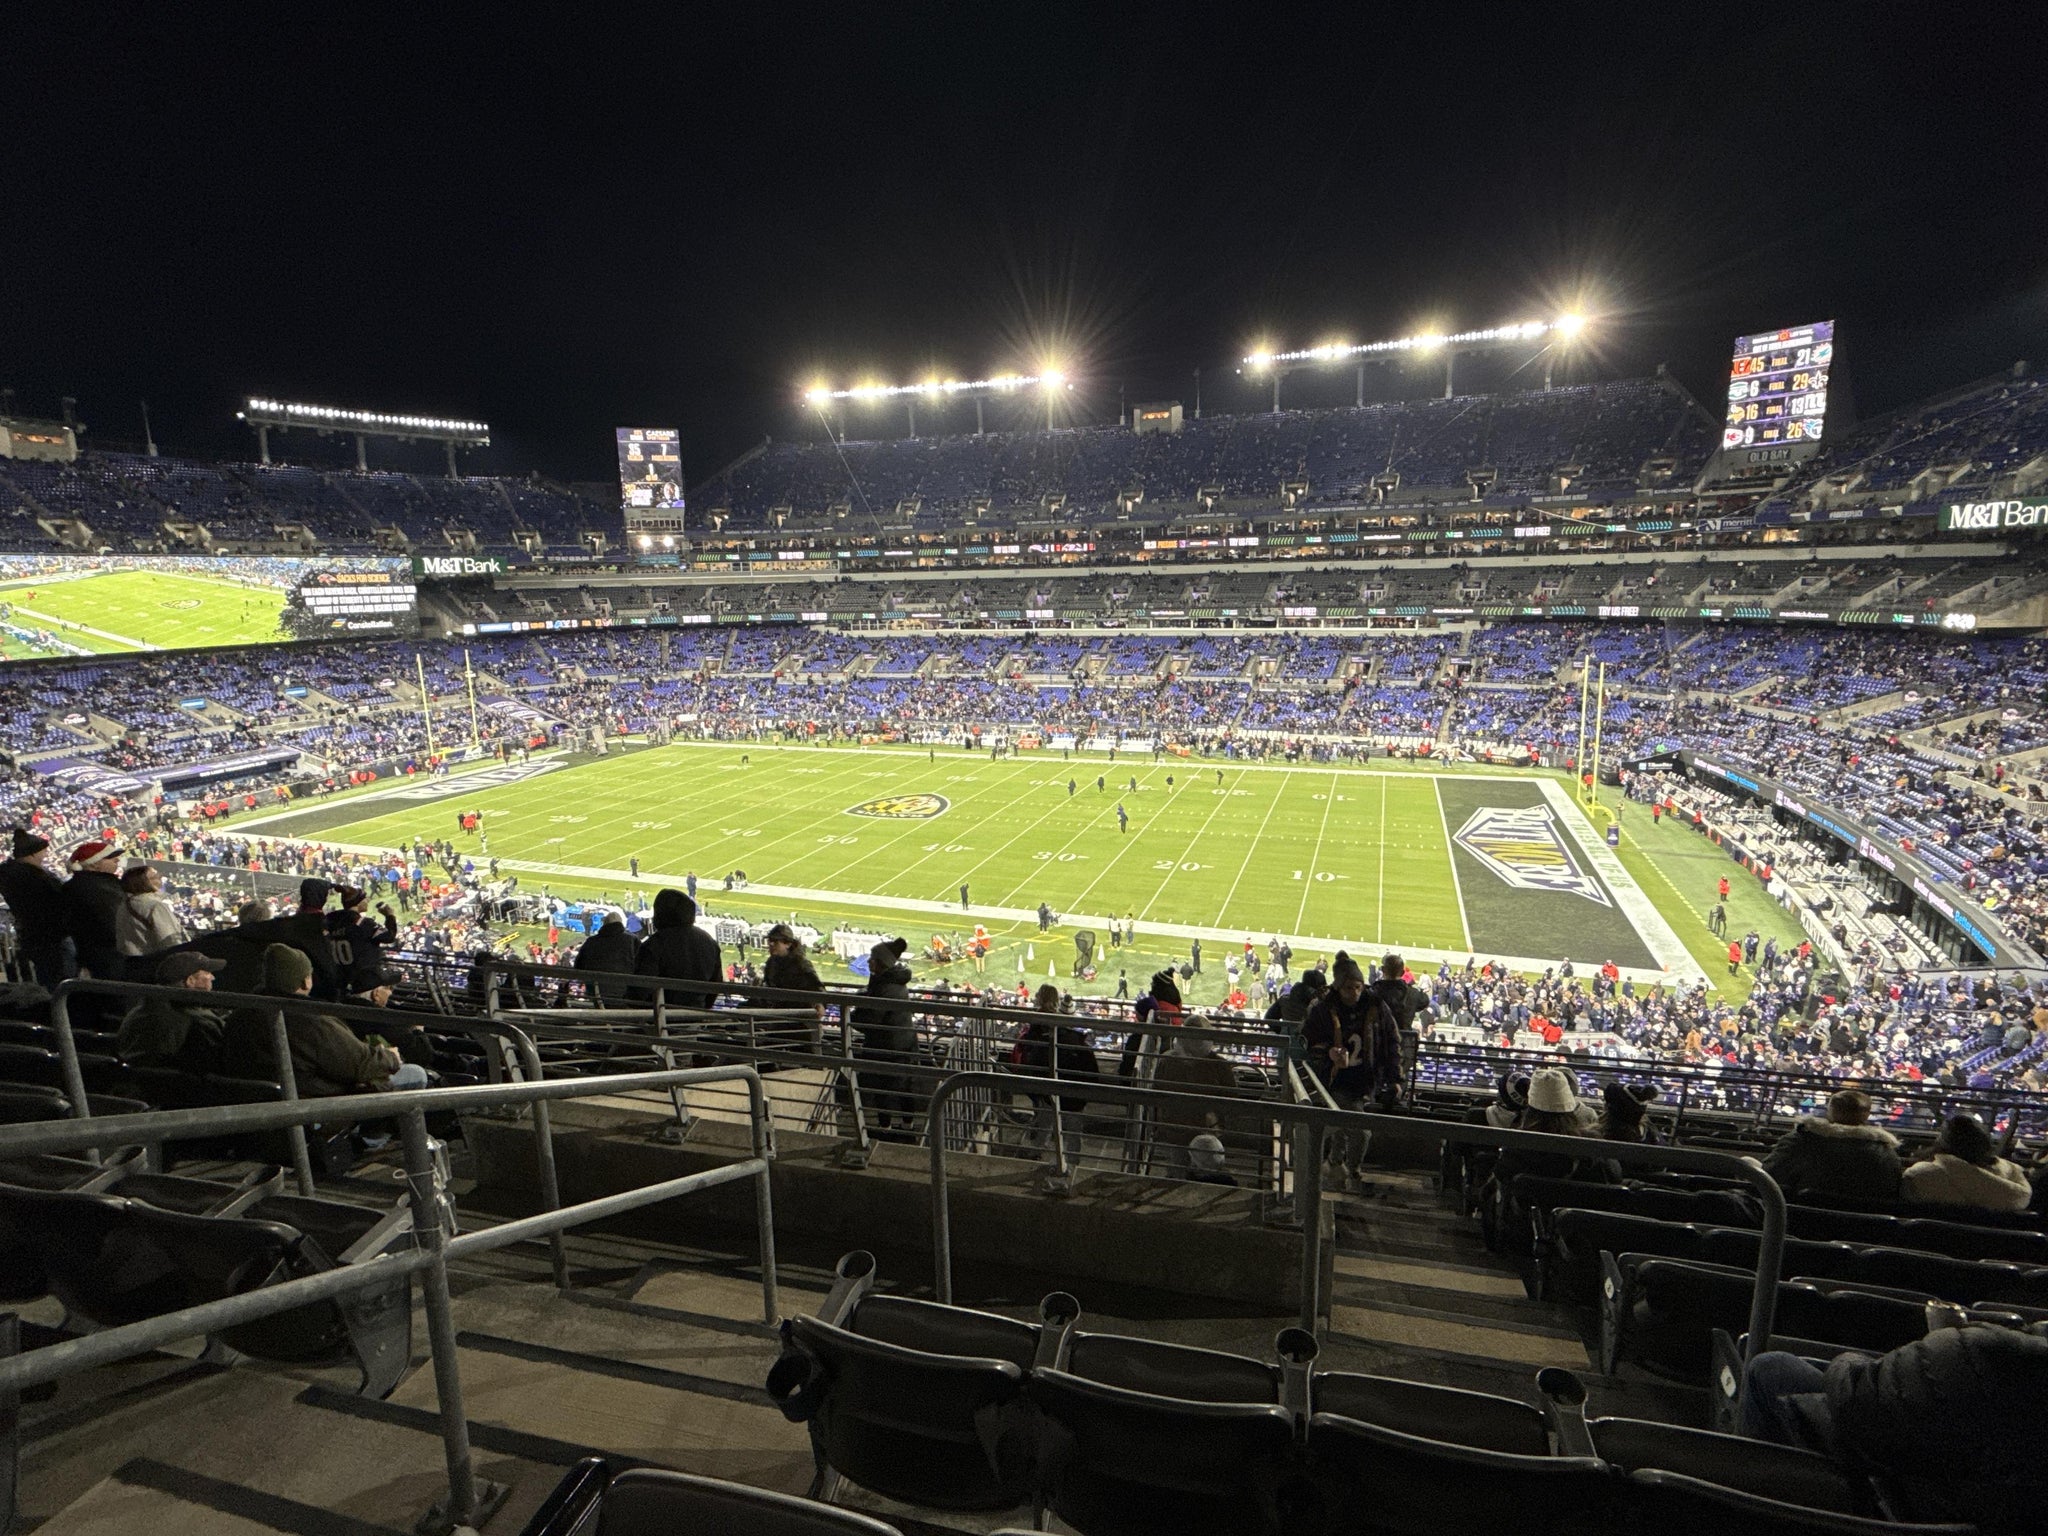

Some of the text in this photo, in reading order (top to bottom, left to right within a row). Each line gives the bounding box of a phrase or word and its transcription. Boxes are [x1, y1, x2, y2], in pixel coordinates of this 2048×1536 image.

[1750, 355, 1765, 373] 45
[1796, 348, 1811, 366] 21
[1749, 380, 1760, 397] 6
[1792, 373, 1810, 391] 29
[1746, 403, 1759, 420] 16
[1744, 425, 1755, 444] 9
[1786, 421, 1803, 440] 26
[1750, 449, 1789, 463] OLD BAY
[1948, 500, 2048, 530] M&T Ban
[423, 557, 500, 574] M&T Bank
[1598, 606, 1611, 616] TRY
[719, 828, 762, 837] 40
[817, 834, 859, 844] 50
[921, 843, 963, 853] 40
[1032, 851, 1077, 862] 30
[1454, 804, 1612, 908] BALTIMORE
[1152, 860, 1201, 871] 20
[1289, 870, 1336, 882] 10
